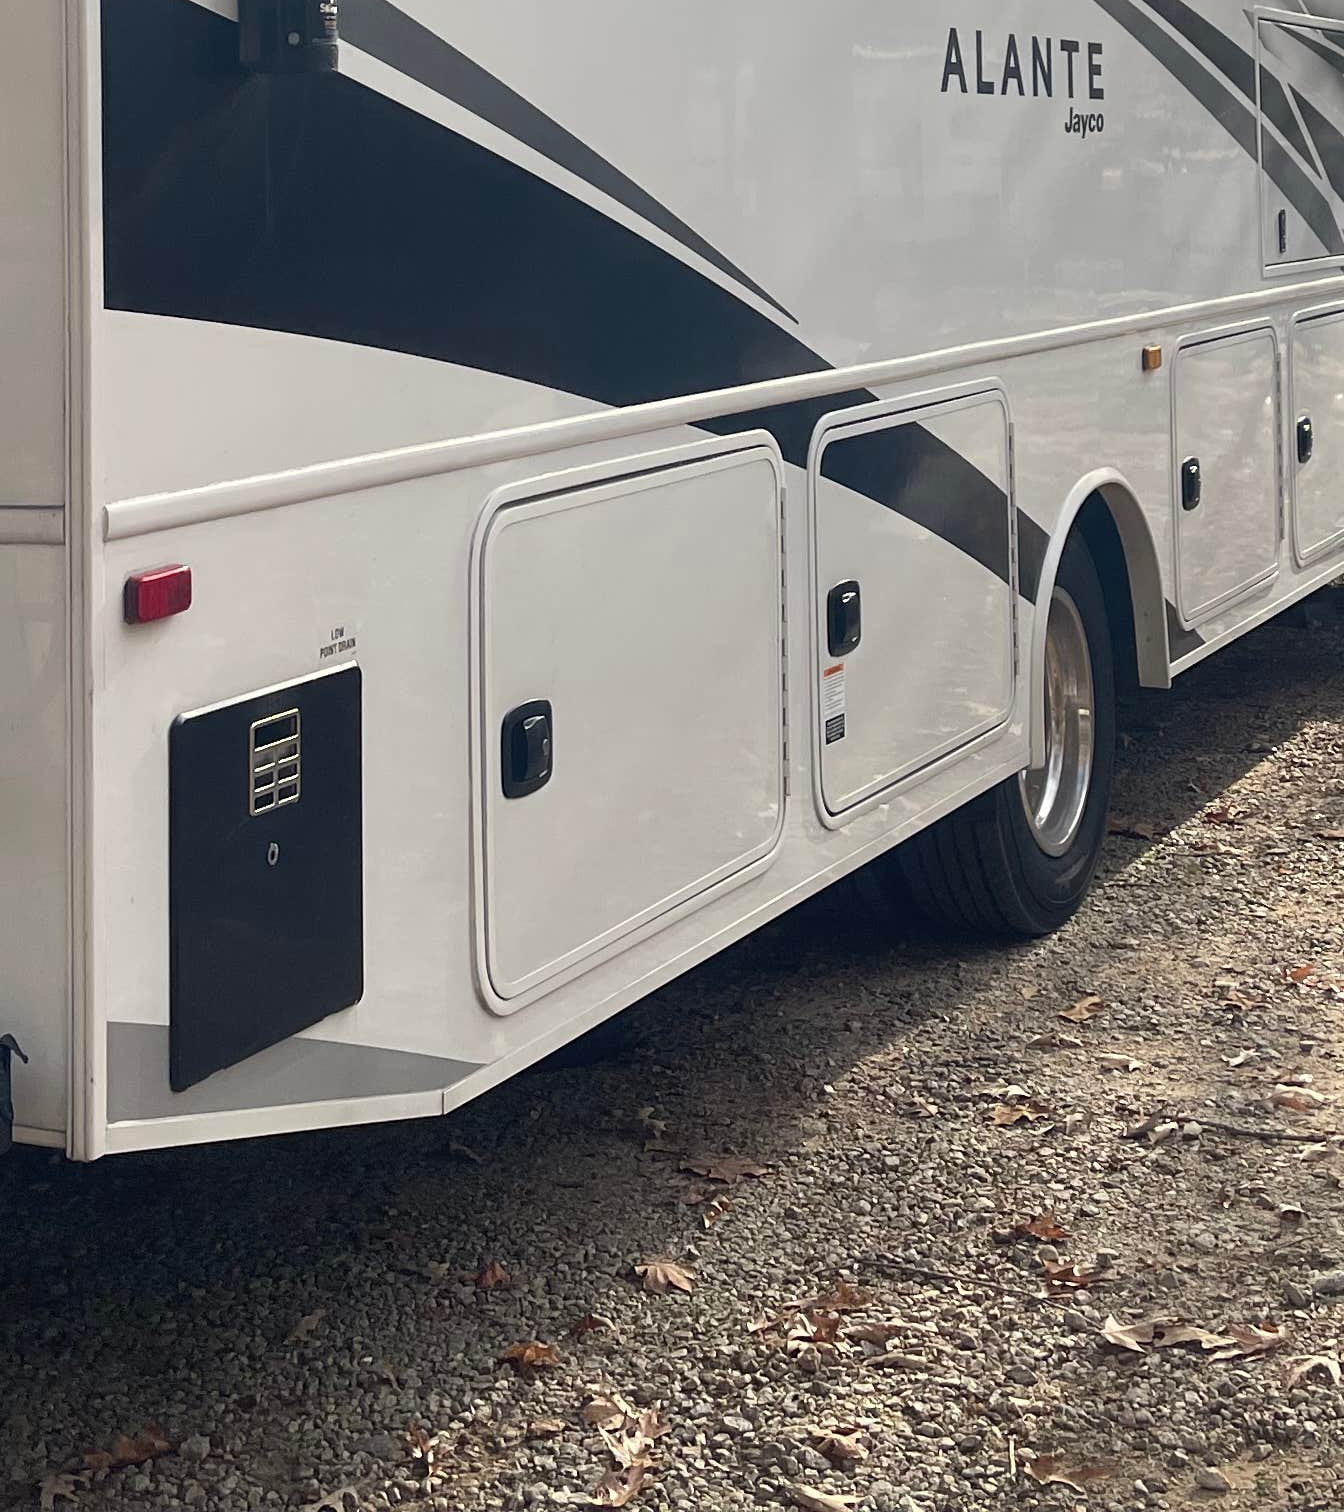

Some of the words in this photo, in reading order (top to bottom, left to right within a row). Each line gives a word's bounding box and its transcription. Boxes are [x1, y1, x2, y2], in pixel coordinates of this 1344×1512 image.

[940, 27, 1105, 100] ALANTE
[1064, 106, 1105, 139] Jayco
[330, 626, 345, 641] LOW
[319, 642, 338, 659] POINT
